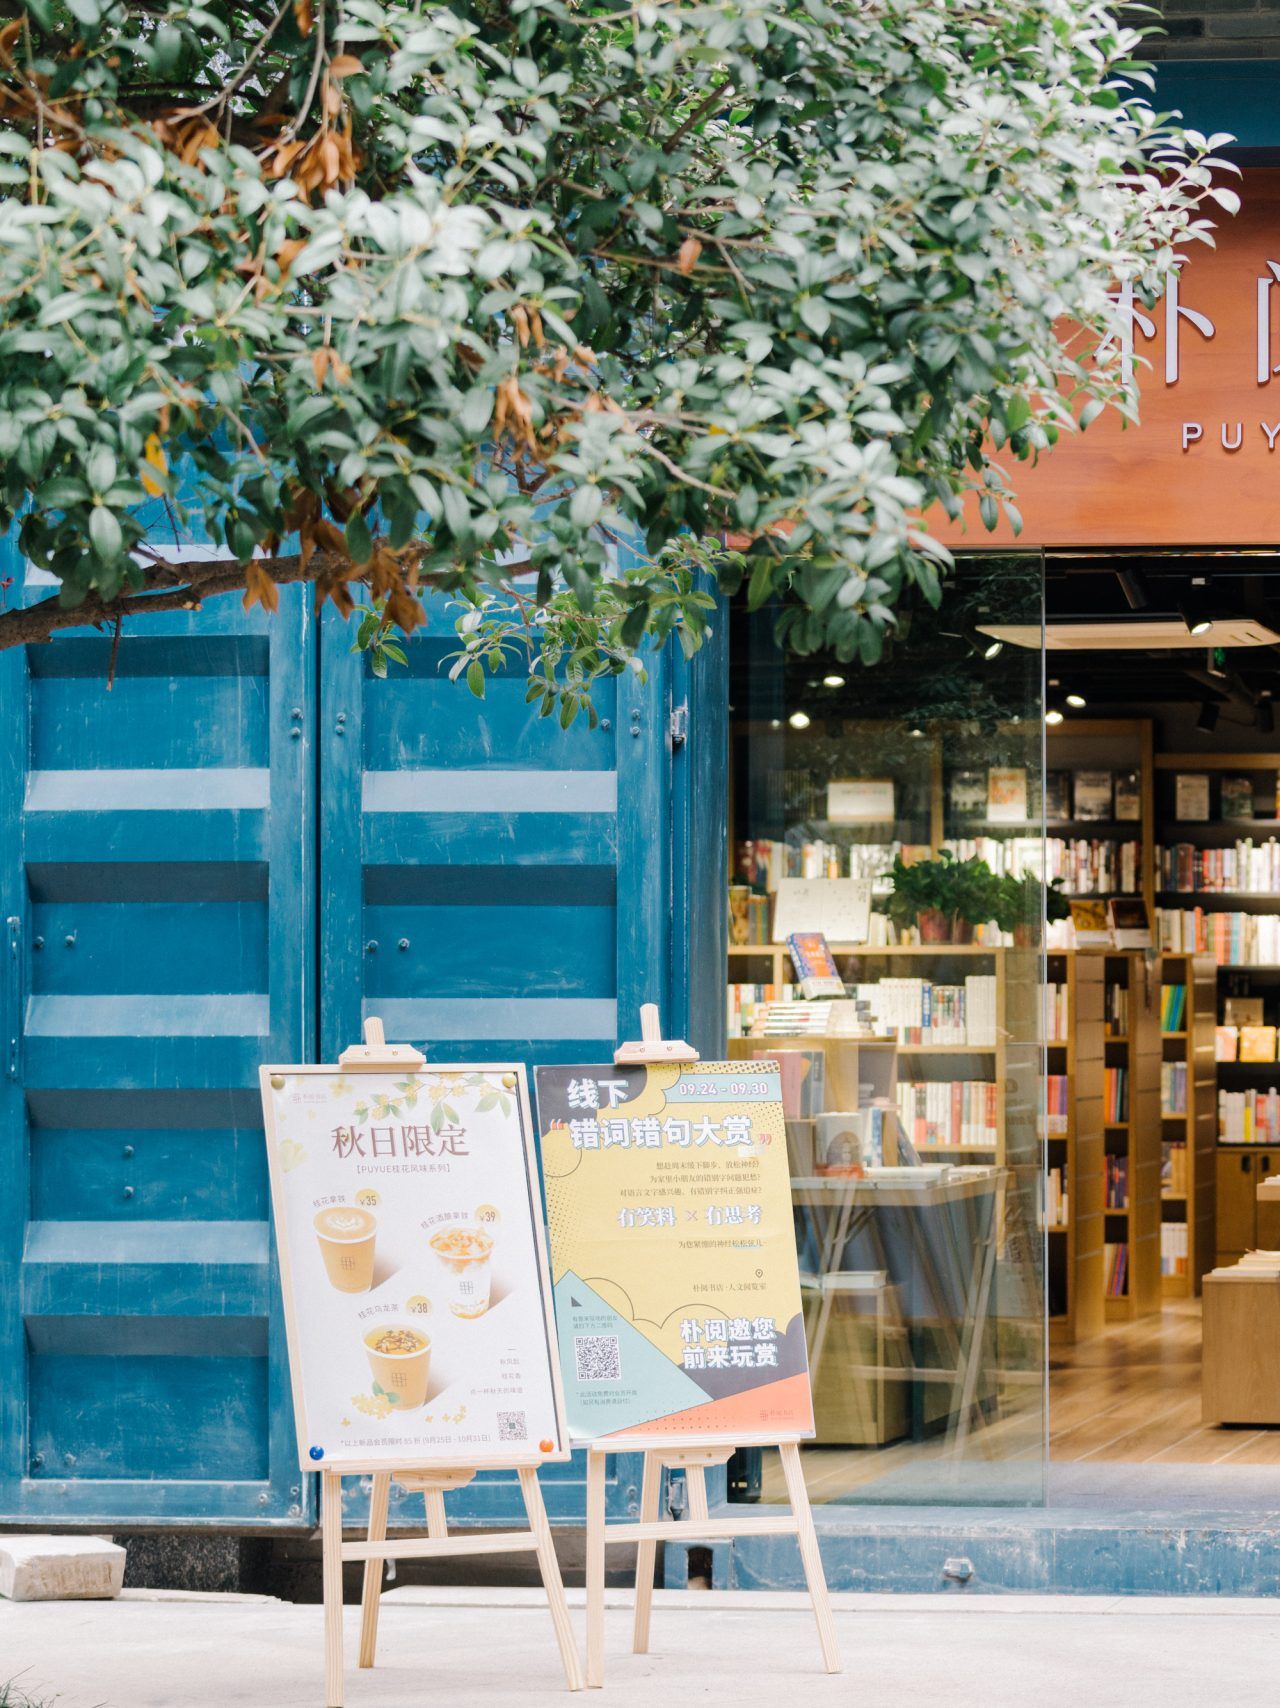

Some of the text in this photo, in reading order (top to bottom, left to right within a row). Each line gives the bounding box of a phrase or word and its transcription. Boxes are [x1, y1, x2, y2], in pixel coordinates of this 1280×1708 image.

[567, 1078, 628, 1108] 线下
[680, 1082, 717, 1096] 09.24
[730, 1081, 769, 1095] 09.30
[331, 1124, 470, 1158] 秋日限定
[617, 1206, 676, 1228] 有笑料
[705, 1204, 763, 1225] 有思考
[680, 1317, 777, 1344] 朴阅邀您
[681, 1344, 779, 1369] 前来玩赏
